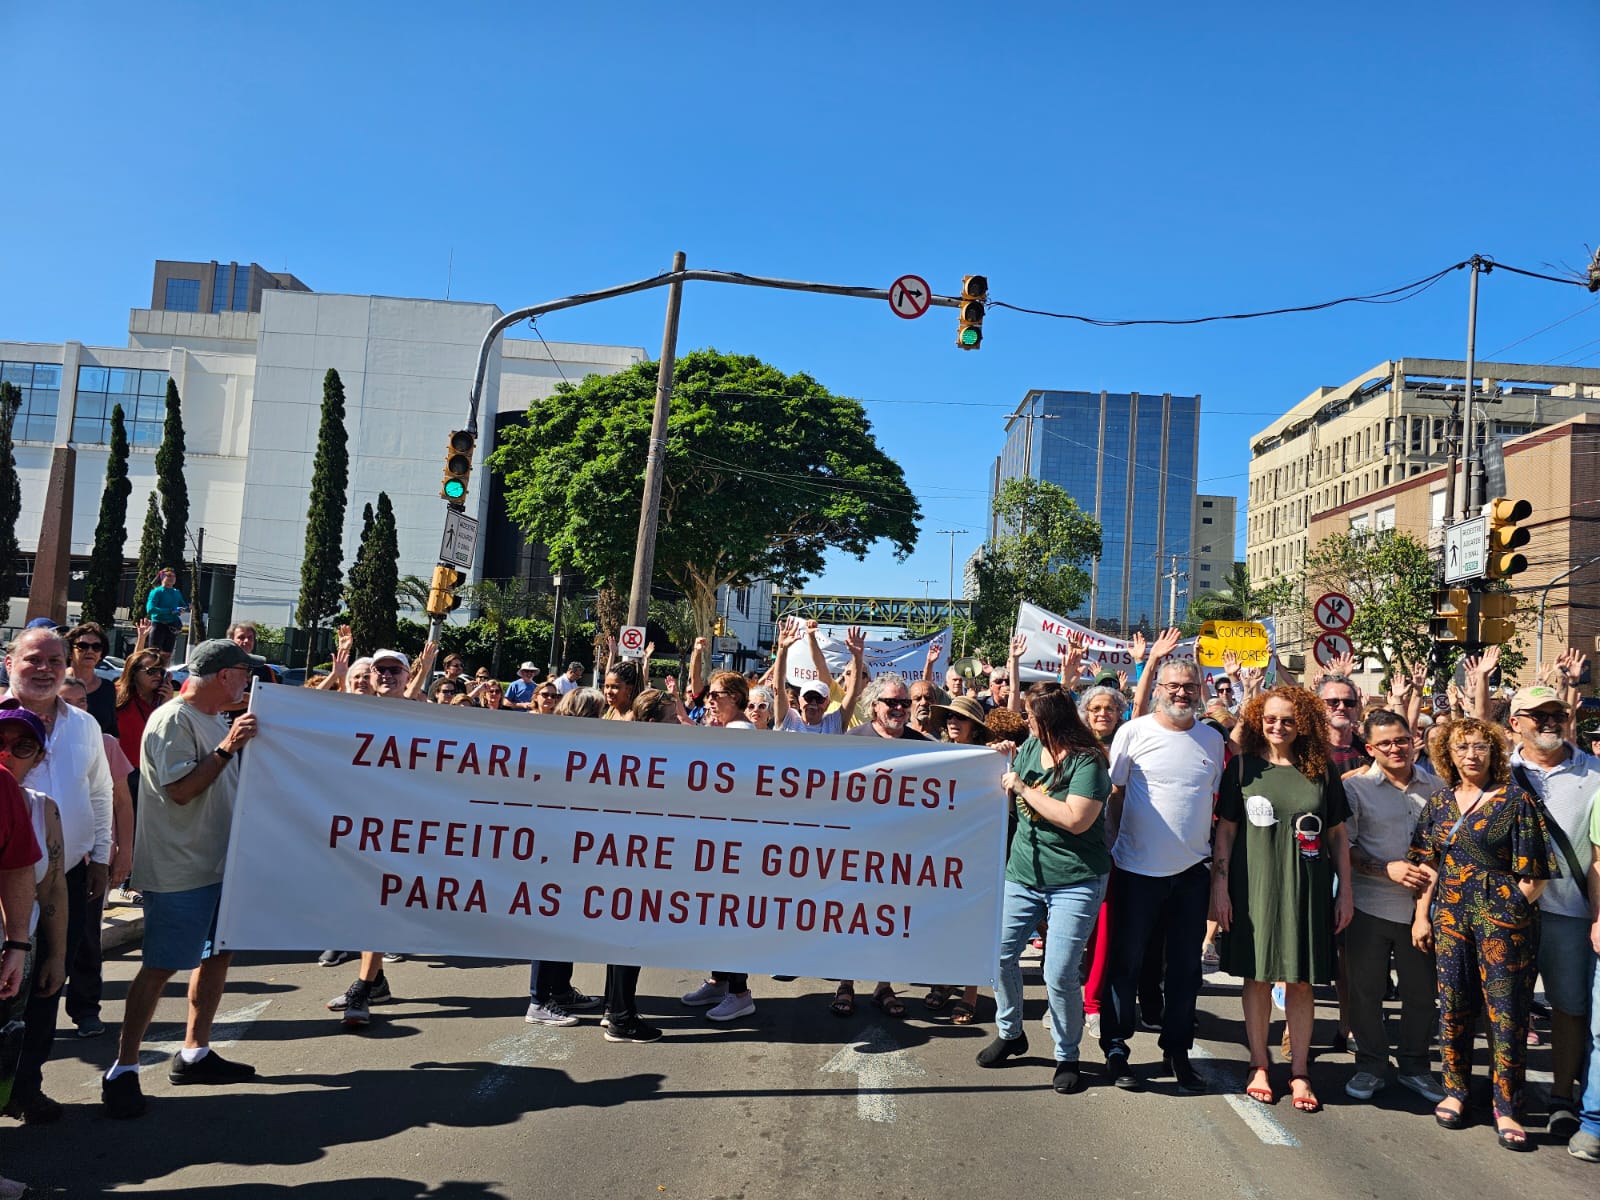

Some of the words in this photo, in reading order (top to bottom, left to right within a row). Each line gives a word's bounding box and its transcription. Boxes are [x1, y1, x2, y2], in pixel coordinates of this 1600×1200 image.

[1042, 619, 1106, 647] MENNO
[1057, 644, 1089, 661] NO
[1098, 651, 1132, 665] AOS
[1222, 645, 1268, 662] ÁVORES
[352, 733, 540, 782] ZAFFARI,
[565, 752, 667, 788] PARE
[687, 760, 735, 795] OS
[755, 765, 957, 810] ESPIGÕES!
[329, 815, 549, 865] PREFEITO,
[573, 830, 675, 871] PARE
[695, 839, 743, 874] DE
[761, 844, 963, 890] GOVERNAR
[379, 874, 487, 912] PARA
[509, 882, 562, 917] AS
[583, 886, 912, 939] CONSTRUTORAS!
